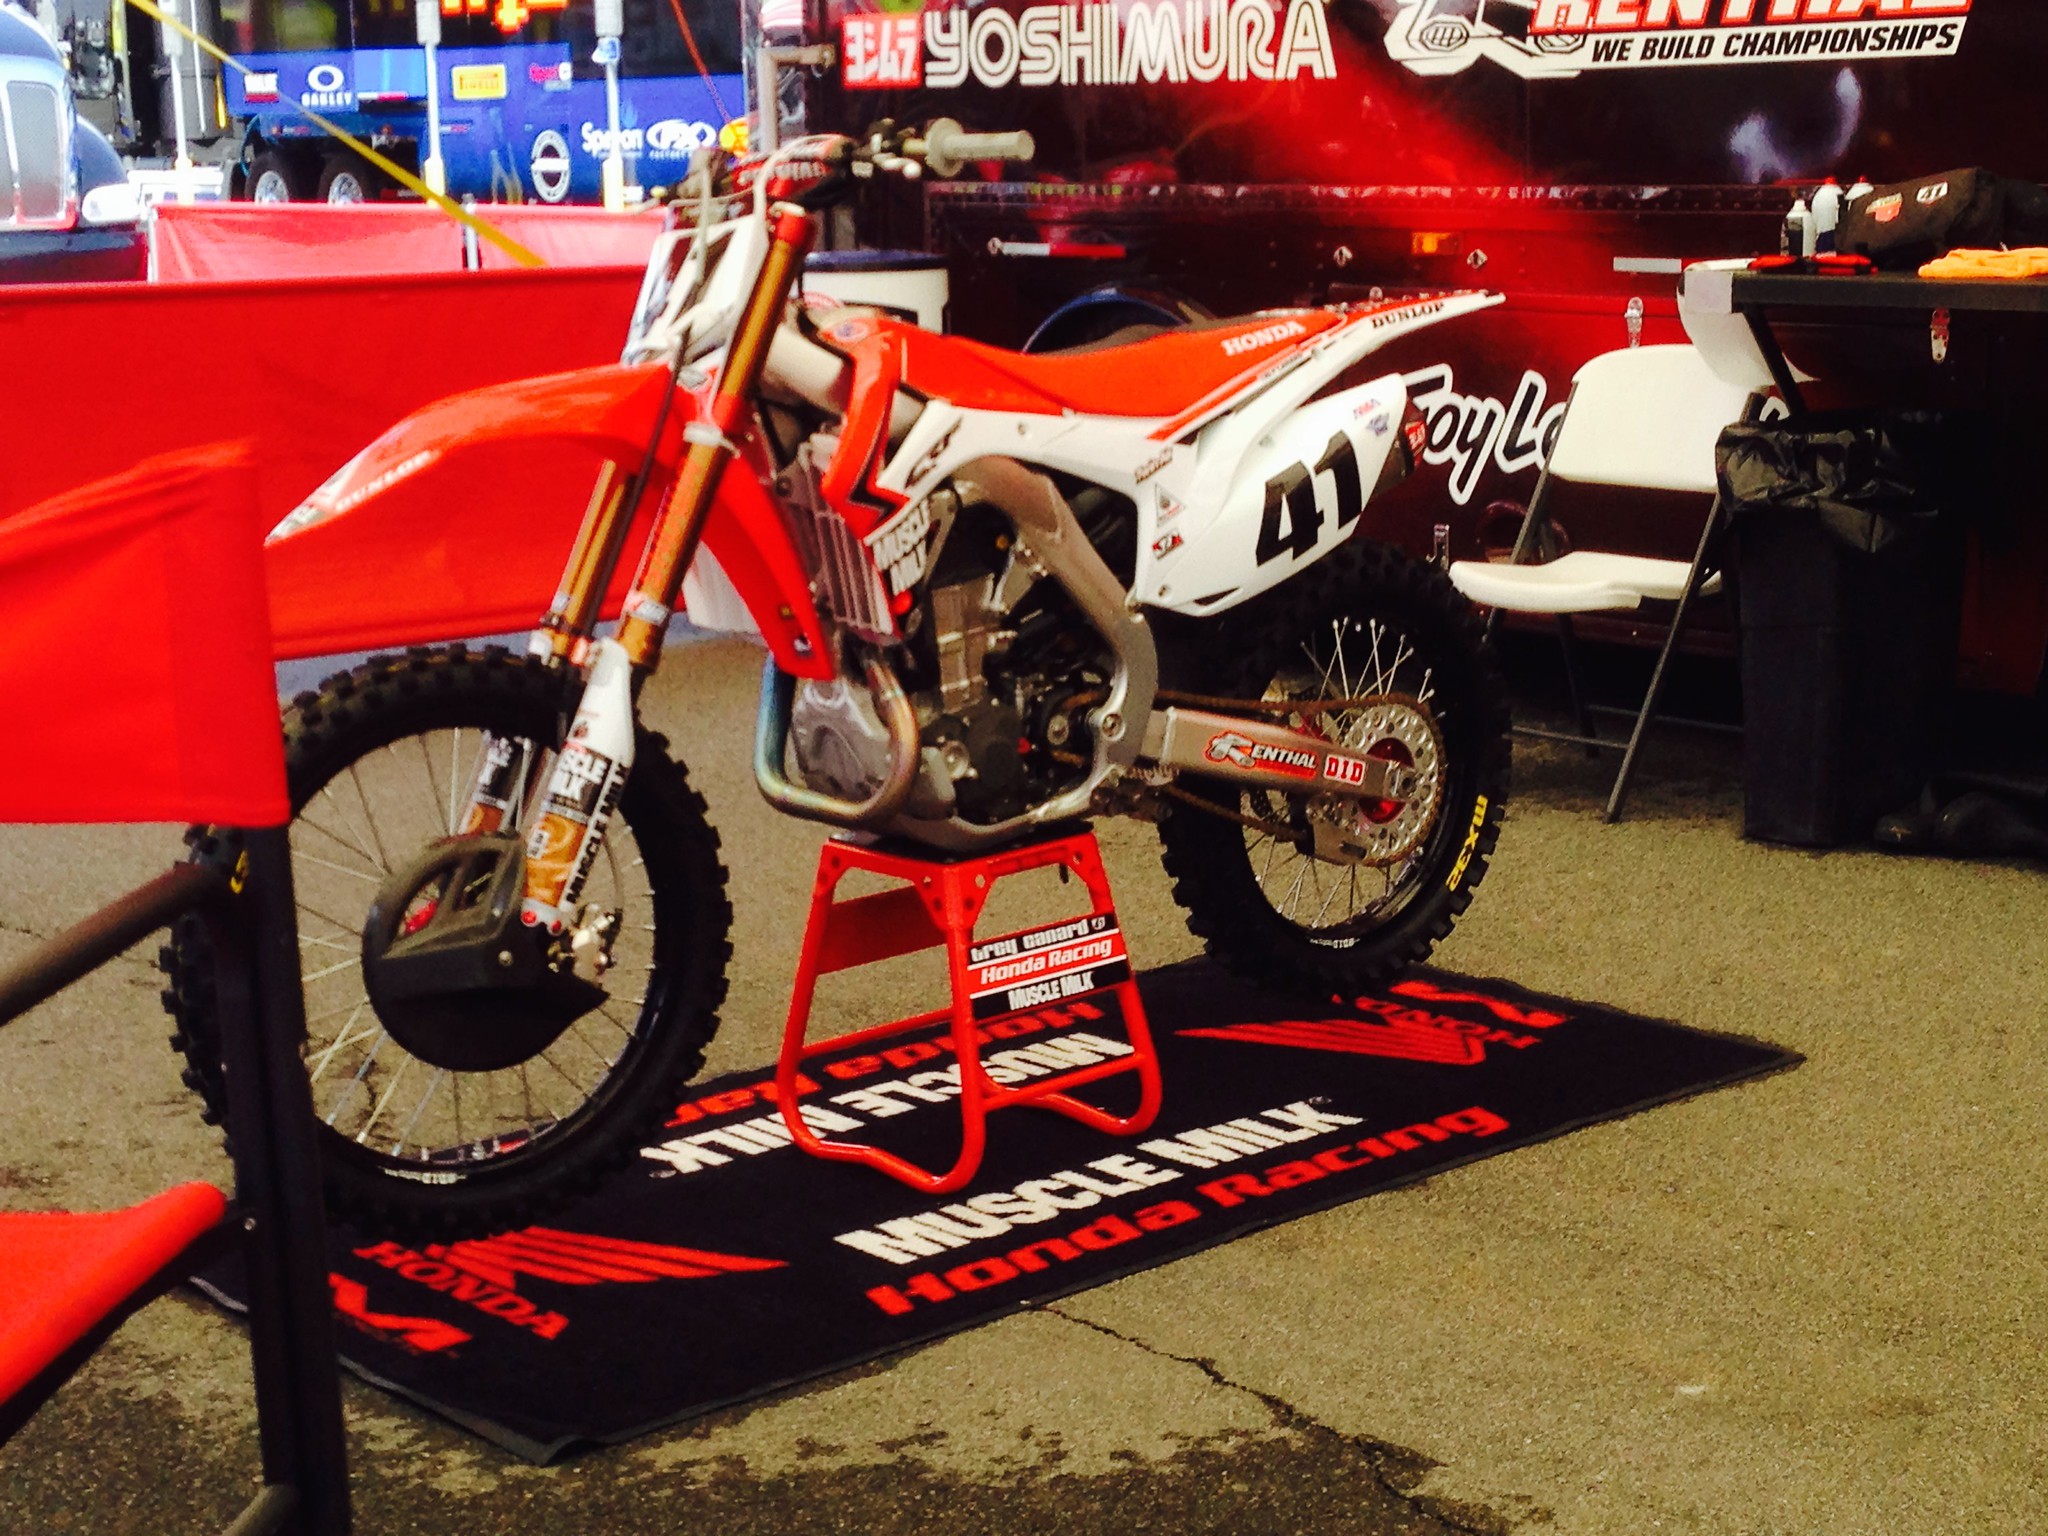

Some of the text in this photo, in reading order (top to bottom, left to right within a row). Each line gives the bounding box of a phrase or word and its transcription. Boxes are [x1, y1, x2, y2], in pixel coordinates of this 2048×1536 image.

[925, 0, 1337, 88] YOSHIMURA
[1591, 22, 1957, 63] WE BUILD CHAMPIONSHIPS
[1371, 301, 1445, 330] DUNLOP
[1220, 321, 1306, 357] HONDA
[1255, 429, 1363, 568] 41
[1207, 732, 1318, 770] RENTHAL
[1326, 756, 1364, 784] DID
[981, 938, 1113, 985] Honda Racing
[1007, 971, 1095, 1011] MUSCLE MILK
[832, 1100, 1366, 1265] MUSCLE MILK
[865, 1106, 1511, 1317] Honda Racing
[352, 1241, 570, 1340] HONDA
